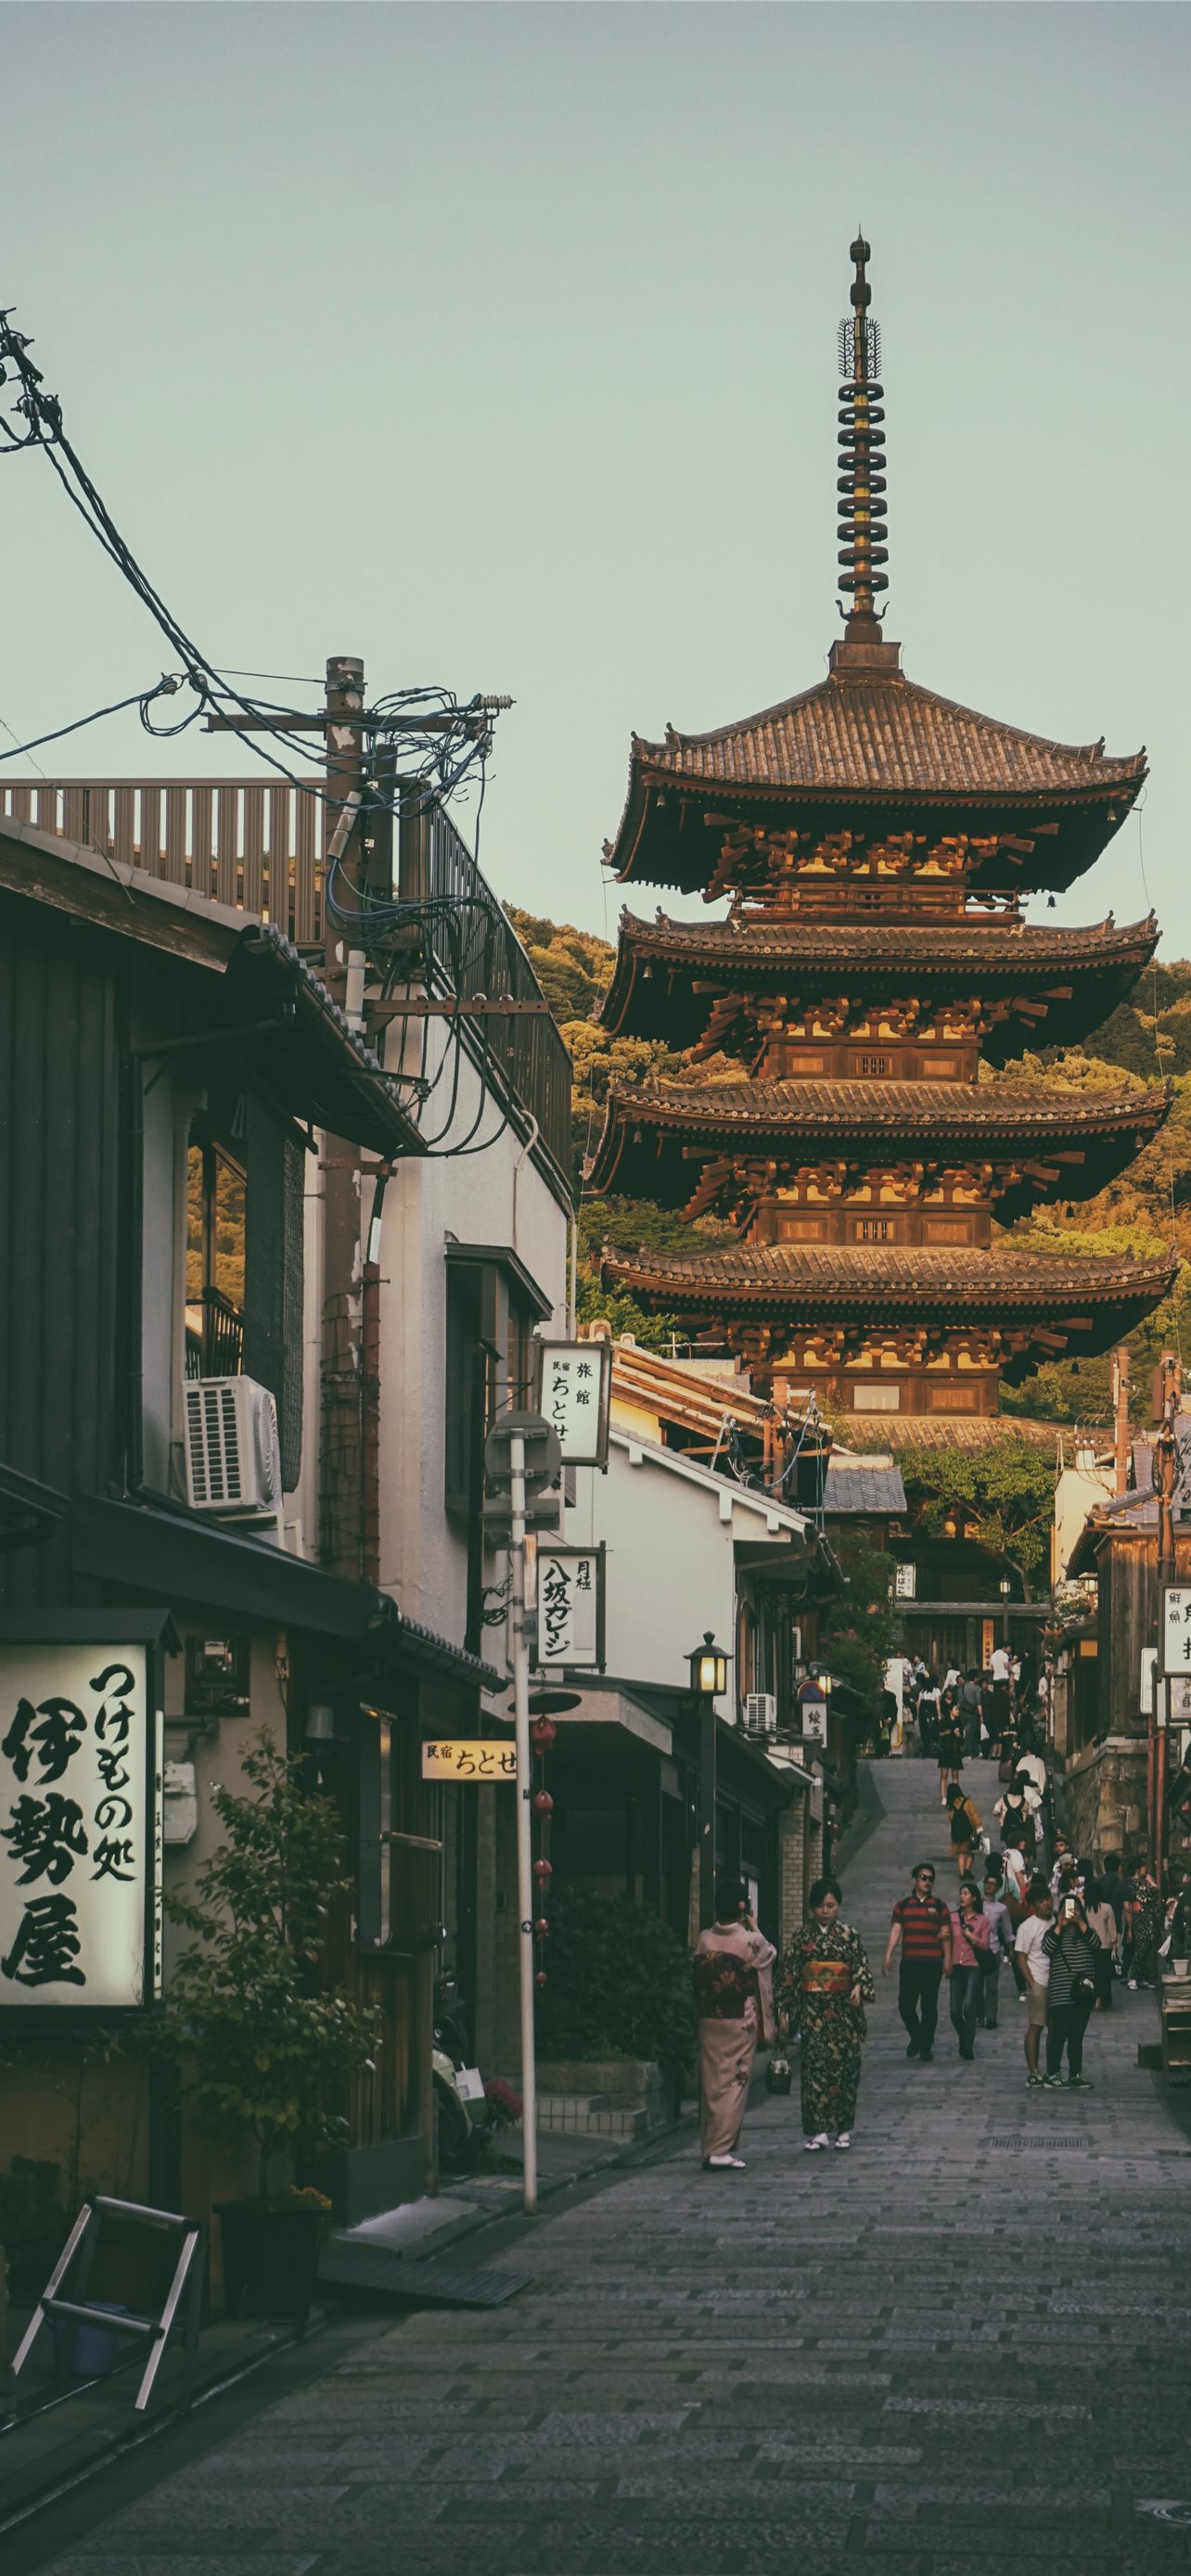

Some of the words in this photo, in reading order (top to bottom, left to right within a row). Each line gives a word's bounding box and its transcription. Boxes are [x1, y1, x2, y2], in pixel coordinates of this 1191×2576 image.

[552, 1360, 570, 1371] 民宿
[576, 1362, 594, 1405] 旅館
[552, 1376, 569, 1442] ちとせ
[575, 1560, 592, 1590] 月極
[543, 1559, 572, 1657] 八坂ガレージ
[90, 1663, 136, 1881] つけもの処
[428, 1744, 453, 1759] 民宿
[456, 1749, 517, 1775] ちとせ
[1, 1697, 89, 1987] 伊勢屋
